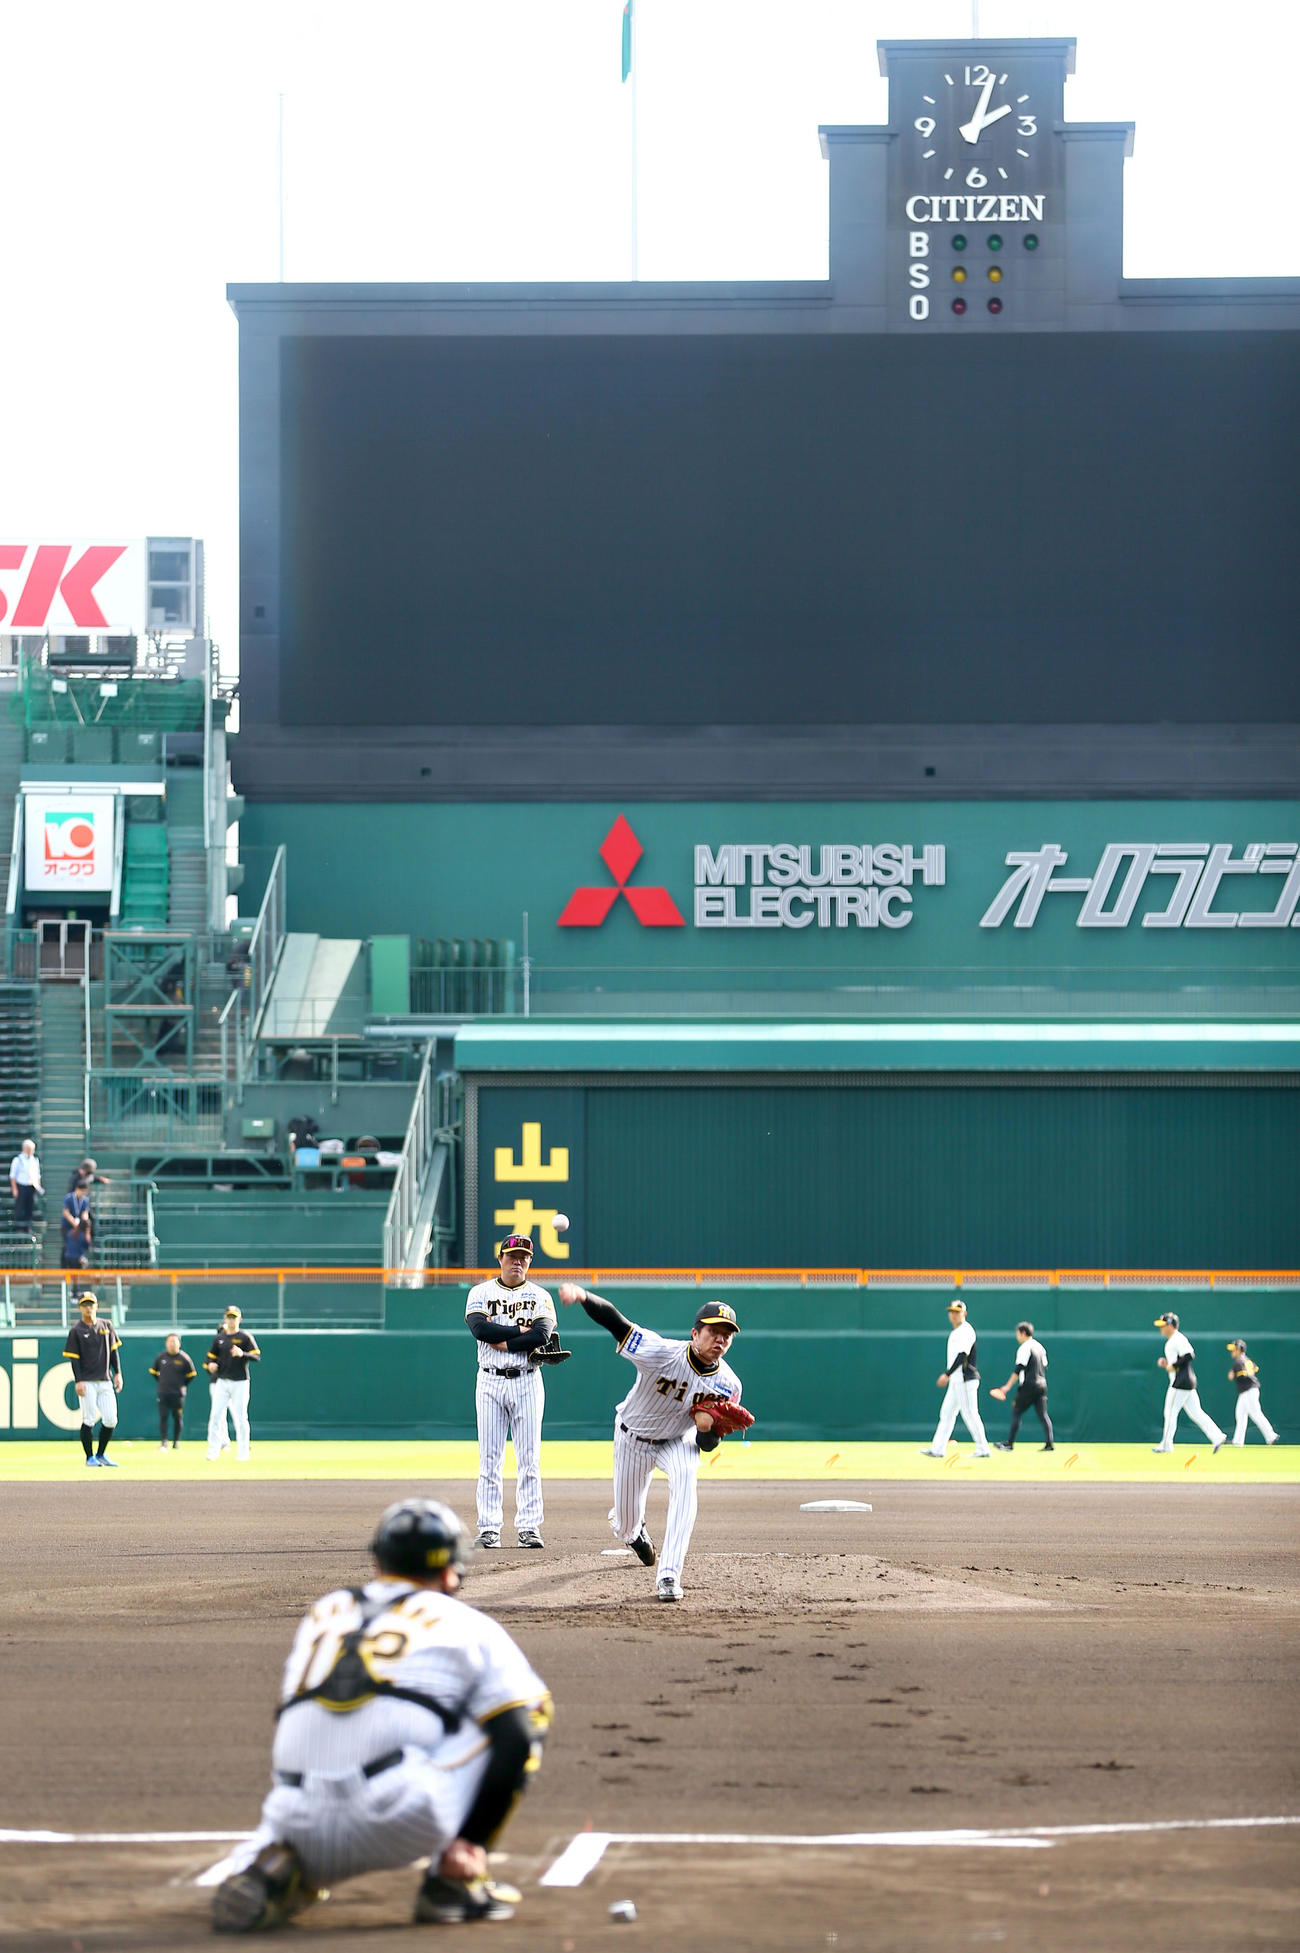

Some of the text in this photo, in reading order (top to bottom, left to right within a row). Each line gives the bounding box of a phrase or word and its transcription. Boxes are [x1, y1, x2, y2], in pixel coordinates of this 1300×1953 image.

[965, 65, 992, 87] 12
[914, 116, 937, 138] 9
[1017, 116, 1038, 136] 3
[965, 167, 988, 188] 6
[906, 195, 1046, 223] CITIZEN
[909, 231, 930, 258] B
[908, 263, 931, 289] S
[909, 294, 930, 320] O
[44, 863, 95, 876] オークワ
[694, 844, 946, 887] MITSUBISHI
[979, 843, 1300, 928] オーロラビジ
[694, 887, 913, 928] ELECTRIC
[487, 1299, 537, 1319] Tigers
